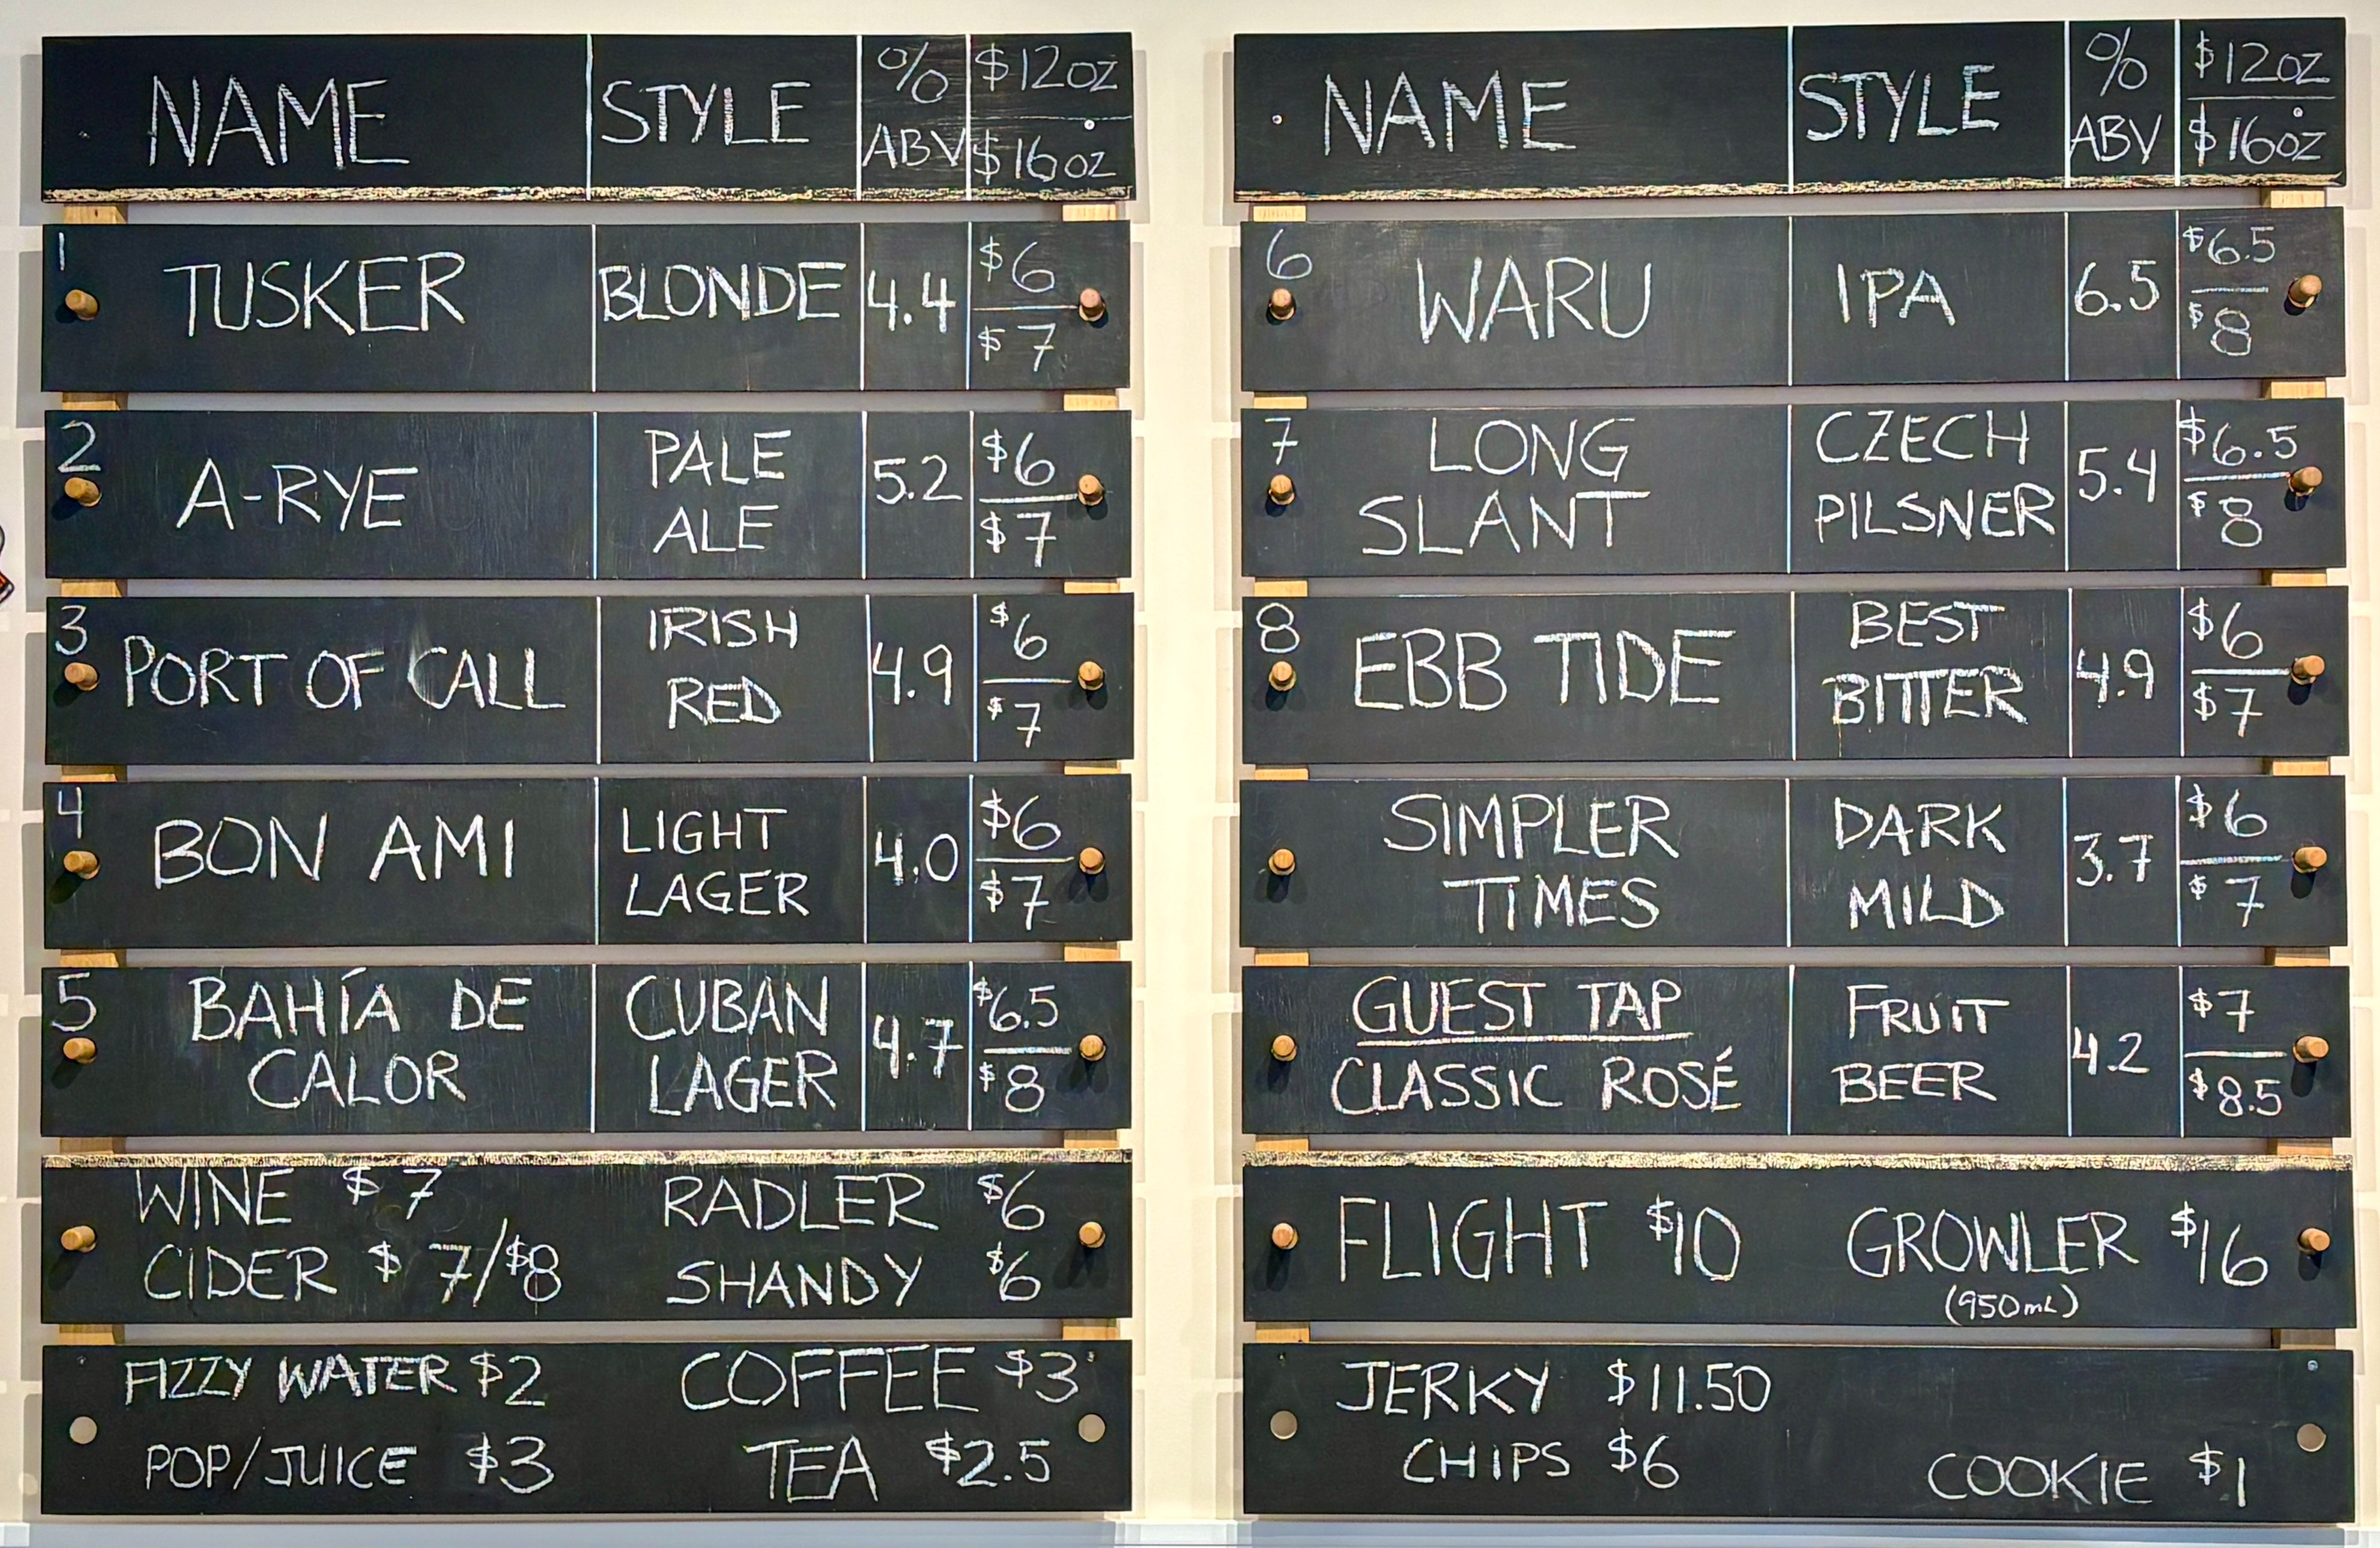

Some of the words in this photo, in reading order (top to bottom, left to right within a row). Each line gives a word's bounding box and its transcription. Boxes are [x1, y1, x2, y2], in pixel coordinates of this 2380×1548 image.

[878, 40, 949, 104] %
[2085, 26, 2148, 96] %
[148, 74, 410, 169] NAME
[602, 80, 810, 145] STYLE
[1323, 70, 1576, 156] NAME
[1799, 62, 2000, 144] STYLE
[862, 122, 966, 170] ABV
[2069, 114, 2161, 164] ABV
[58, 231, 66, 272] 1
[980, 236, 1056, 294] $6
[1266, 227, 1312, 280] 6
[2183, 226, 2276, 266] $6.5
[162, 251, 466, 337] TUSKER
[598, 261, 846, 322] BLONDE
[868, 270, 956, 334] 4.4
[1416, 256, 1652, 344] WARU
[1836, 262, 1956, 328] IPA
[2074, 260, 2160, 317] 6.5
[2189, 302, 2252, 356] $8
[58, 420, 101, 474] 2
[644, 429, 791, 489] PALE
[981, 429, 1056, 487] $6
[1264, 416, 1299, 466] 7
[1429, 417, 1635, 481] LONG
[1816, 409, 2029, 466] CZECH
[2179, 406, 2298, 467] $6.5
[175, 457, 418, 531] A-RYE
[874, 454, 962, 505] 5.2
[2078, 447, 2157, 504] 5.4
[654, 504, 779, 555] ALE
[1359, 489, 1651, 556] SLANT
[1816, 482, 2056, 542] PILSNER
[2189, 491, 2262, 547] $8
[54, 605, 88, 656] 3
[650, 606, 798, 651] IRISH
[990, 602, 1048, 661] $6
[1256, 602, 1301, 654] 8
[1849, 599, 2006, 649] BEST
[2187, 596, 2264, 661] $6
[122, 635, 288, 709] PORT
[306, 647, 385, 711] OF
[407, 645, 566, 711] CALL
[871, 641, 954, 706] 4.9
[1354, 628, 1508, 711] EBB
[1533, 629, 1736, 706] TIDE
[1821, 665, 2029, 727] BITTER
[2076, 647, 2154, 709] 4.9
[668, 676, 782, 729] RED
[56, 786, 84, 839] 4
[621, 806, 789, 855] LIGHT
[981, 789, 1061, 852] $6
[1383, 793, 1680, 860] SIMPLER
[1834, 796, 2006, 857] DARK
[2187, 782, 2268, 839] $6
[154, 812, 328, 891] BON
[369, 812, 515, 882] AMI
[874, 830, 959, 887] 4.0
[2074, 832, 2154, 887] 3.7
[625, 869, 810, 917] LAGER
[1442, 874, 1661, 935] TIMES
[1849, 872, 2007, 931] MILD
[51, 971, 98, 1033] 5
[188, 966, 401, 1042] BAHÍA
[450, 977, 534, 1032] DE
[624, 974, 830, 1041] CUBAN
[972, 977, 1059, 1033] $6.5
[1351, 975, 1548, 1036] GUEST
[1576, 979, 1683, 1033] TAP
[1846, 984, 2011, 1040] FRUIT
[872, 1014, 964, 1080] 4.7
[2071, 1026, 2150, 1076] 4.2
[246, 1047, 468, 1110] CALOR
[649, 1048, 838, 1117] LAGER
[979, 1062, 1045, 1114] $8
[1329, 1056, 1563, 1116] CLASSIC
[1601, 1045, 1742, 1112] ROSÉ
[1831, 1060, 1999, 1105] BEER
[2189, 1070, 2284, 1117] $8.5
[134, 1167, 294, 1230] WINE
[664, 1172, 939, 1232] RADLER
[977, 1169, 1045, 1232] $6
[1339, 1194, 1609, 1283] FLIGHT
[1646, 1192, 1742, 1283] $10
[1846, 1206, 2140, 1279] GROWLER
[2170, 1201, 2269, 1289] $16
[142, 1242, 339, 1302] CIDER
[666, 1255, 924, 1309] SHANDY
[985, 1241, 1042, 1302] $6
[1944, 1283, 2079, 1326] (950mL)
[124, 1355, 253, 1407] FIZZY
[278, 1352, 459, 1404] WATER
[469, 1351, 546, 1407] $2
[680, 1344, 980, 1414] COFFEE
[994, 1350, 1080, 1404] $3
[1335, 1359, 1551, 1421] JERKY
[1608, 1357, 1772, 1415] $11.50
[144, 1426, 418, 1491] POP/JUICE
[464, 1431, 556, 1495] $3
[744, 1434, 880, 1504] TEA
[925, 1429, 1052, 1489] $2.5
[1402, 1437, 1571, 1485] CHIPS
[1608, 1426, 1681, 1490] $6
[1928, 1452, 2154, 1506] COOKIE
[2189, 1441, 2248, 1509] $1
